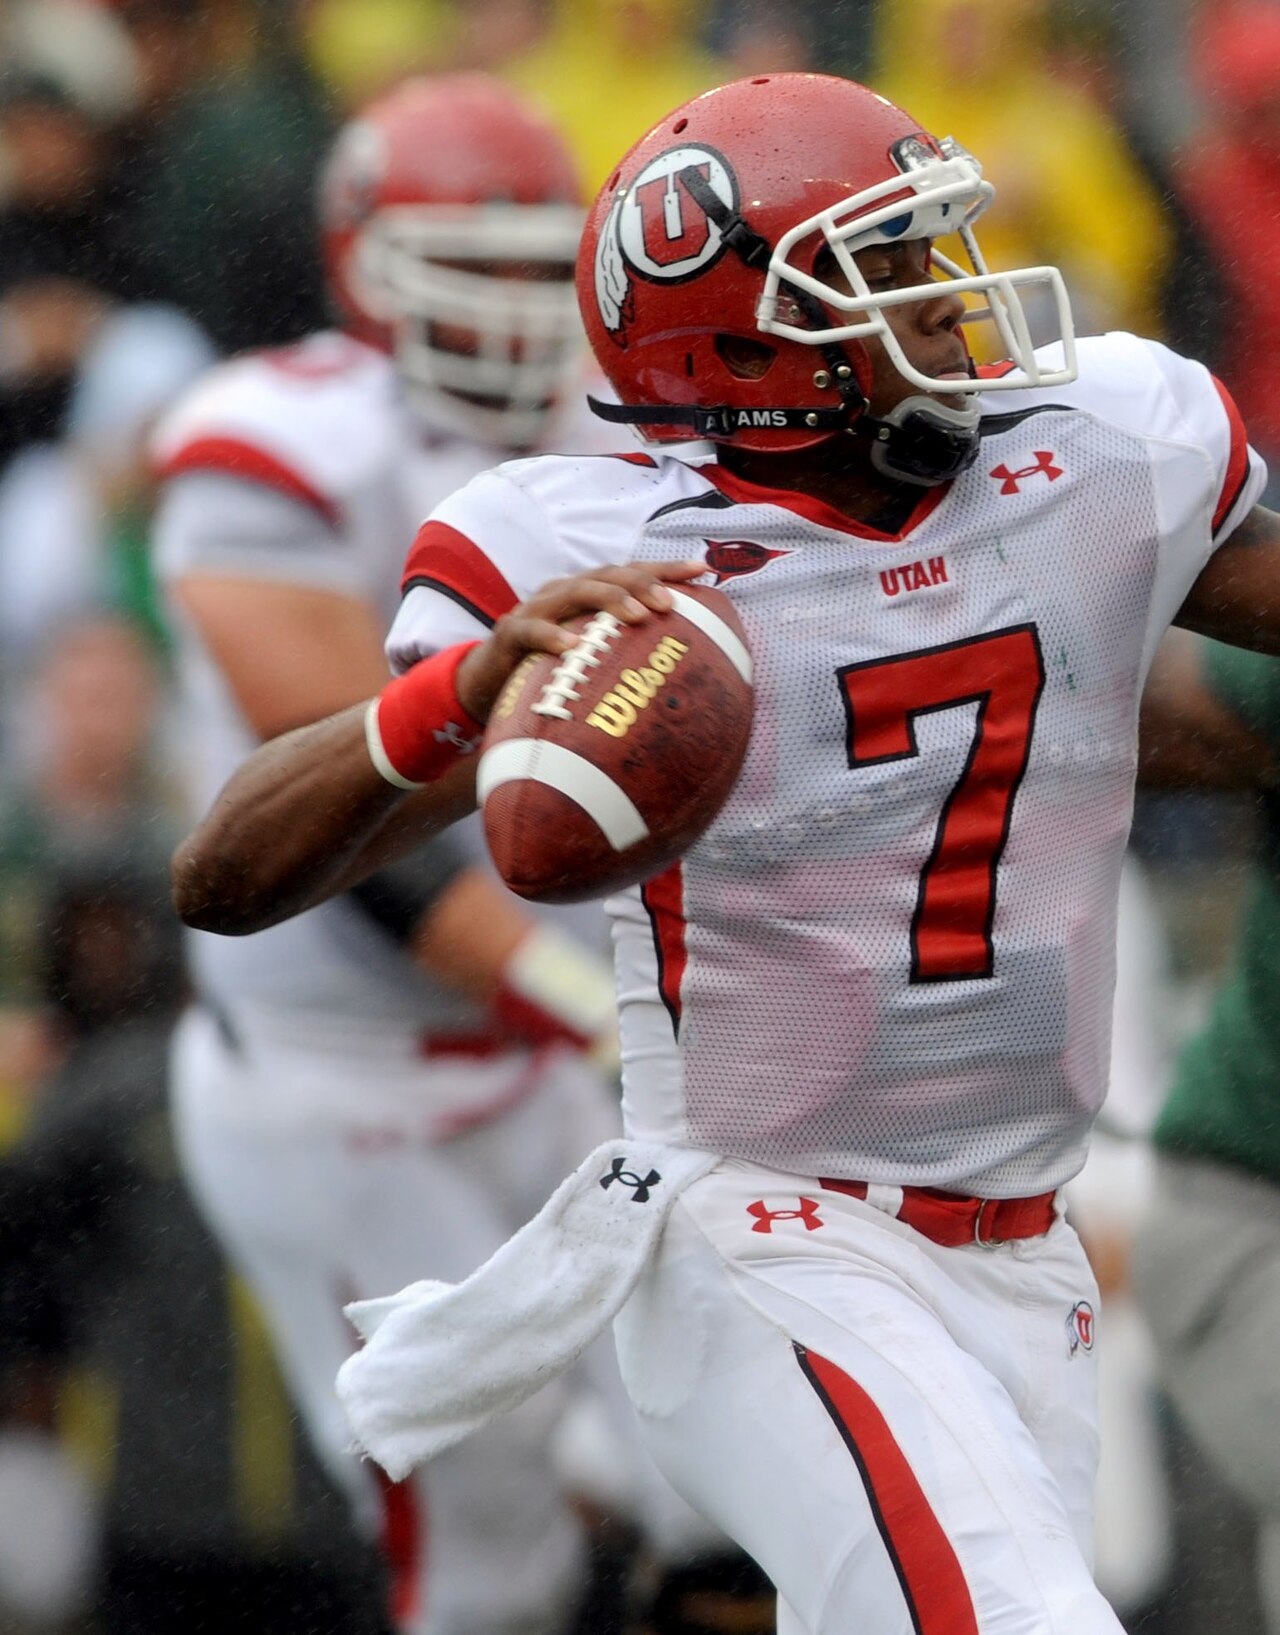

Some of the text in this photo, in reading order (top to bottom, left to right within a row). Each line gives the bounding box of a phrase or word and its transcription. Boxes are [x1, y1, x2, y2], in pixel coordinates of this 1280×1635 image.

[634, 161, 711, 268] U
[705, 410, 788, 430] AAMS
[879, 556, 949, 597] UTAH
[584, 635, 689, 738] Wilson
[835, 621, 1046, 985] 7
